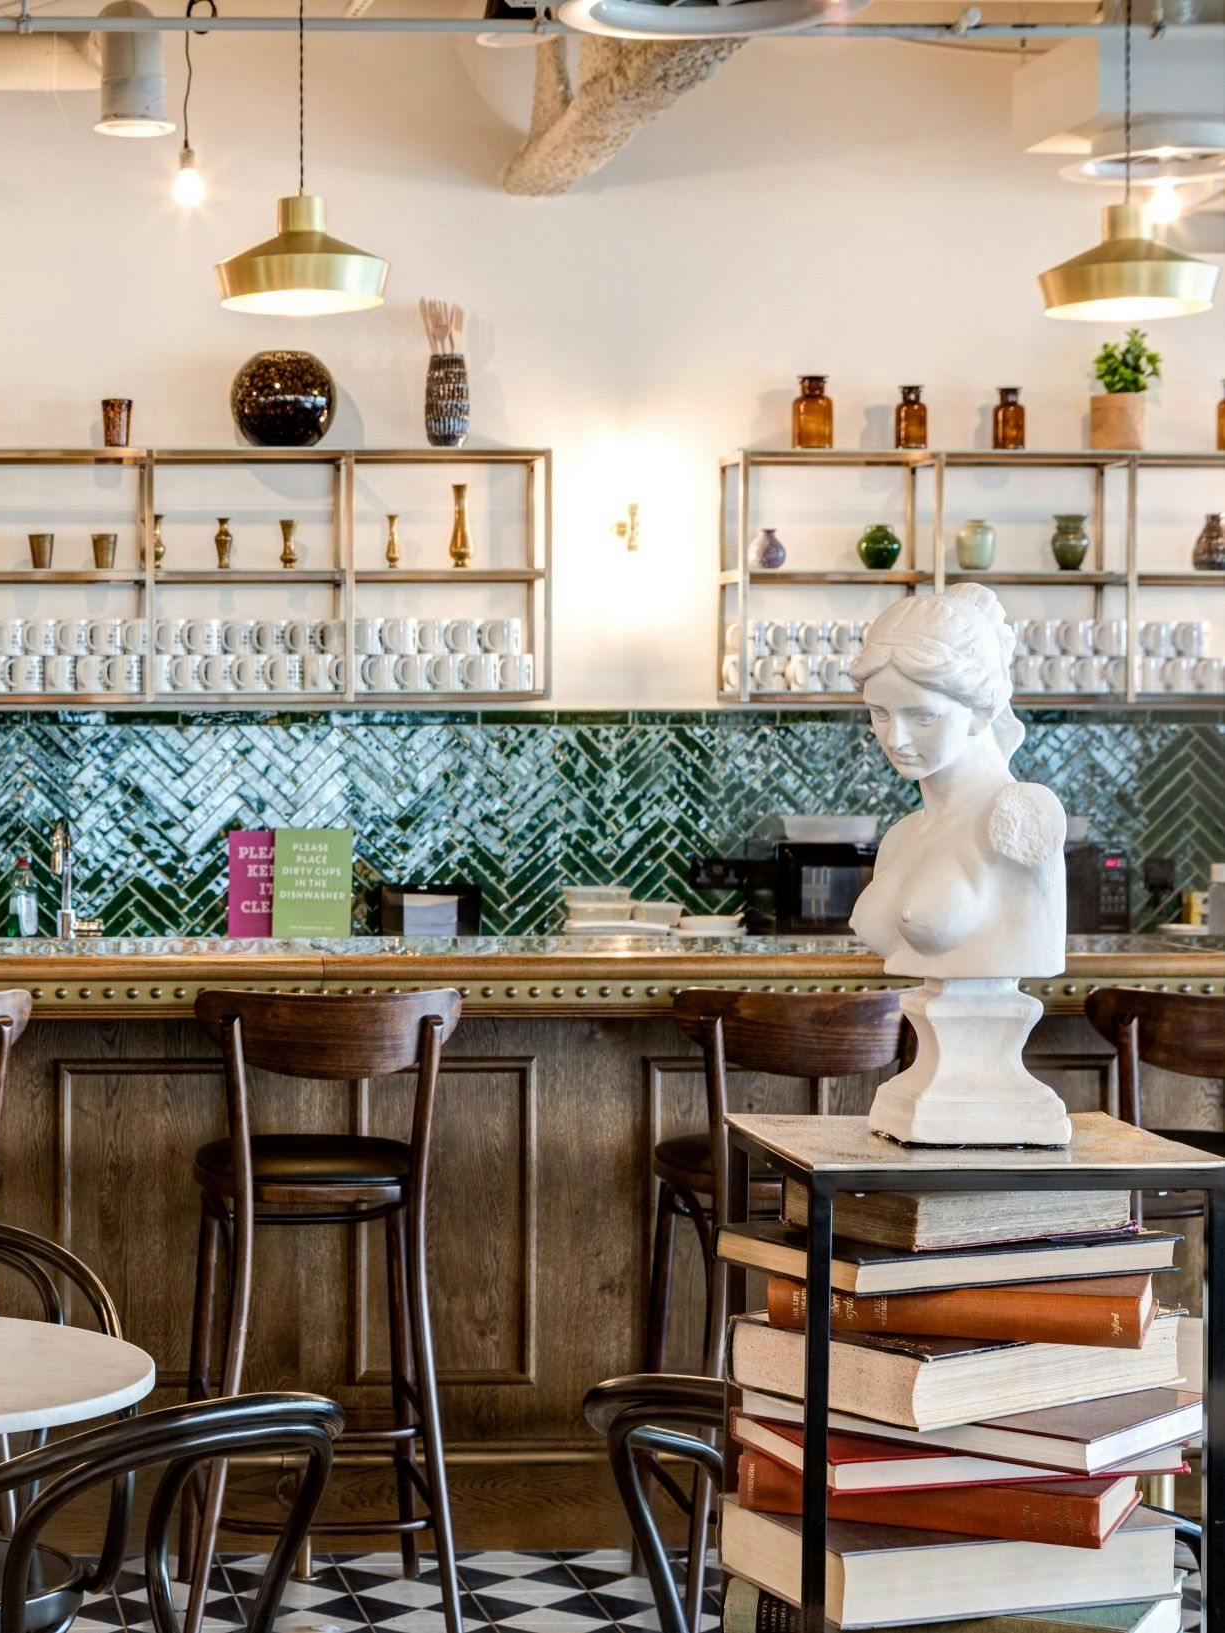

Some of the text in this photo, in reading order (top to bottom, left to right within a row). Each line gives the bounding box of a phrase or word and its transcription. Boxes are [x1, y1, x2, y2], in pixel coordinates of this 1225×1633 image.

[238, 846, 276, 860] PLEA
[293, 843, 329, 852] PLEASE
[296, 855, 328, 864] PLACE
[247, 865, 274, 878] KE
[282, 867, 342, 877] DIRTY CUPS
[295, 879, 328, 888] IN THE
[279, 890, 345, 900] DISHWASHER
[240, 900, 272, 914] CLE
[792, 1290, 800, 1306] LIFE
[831, 1293, 841, 1318] obert
